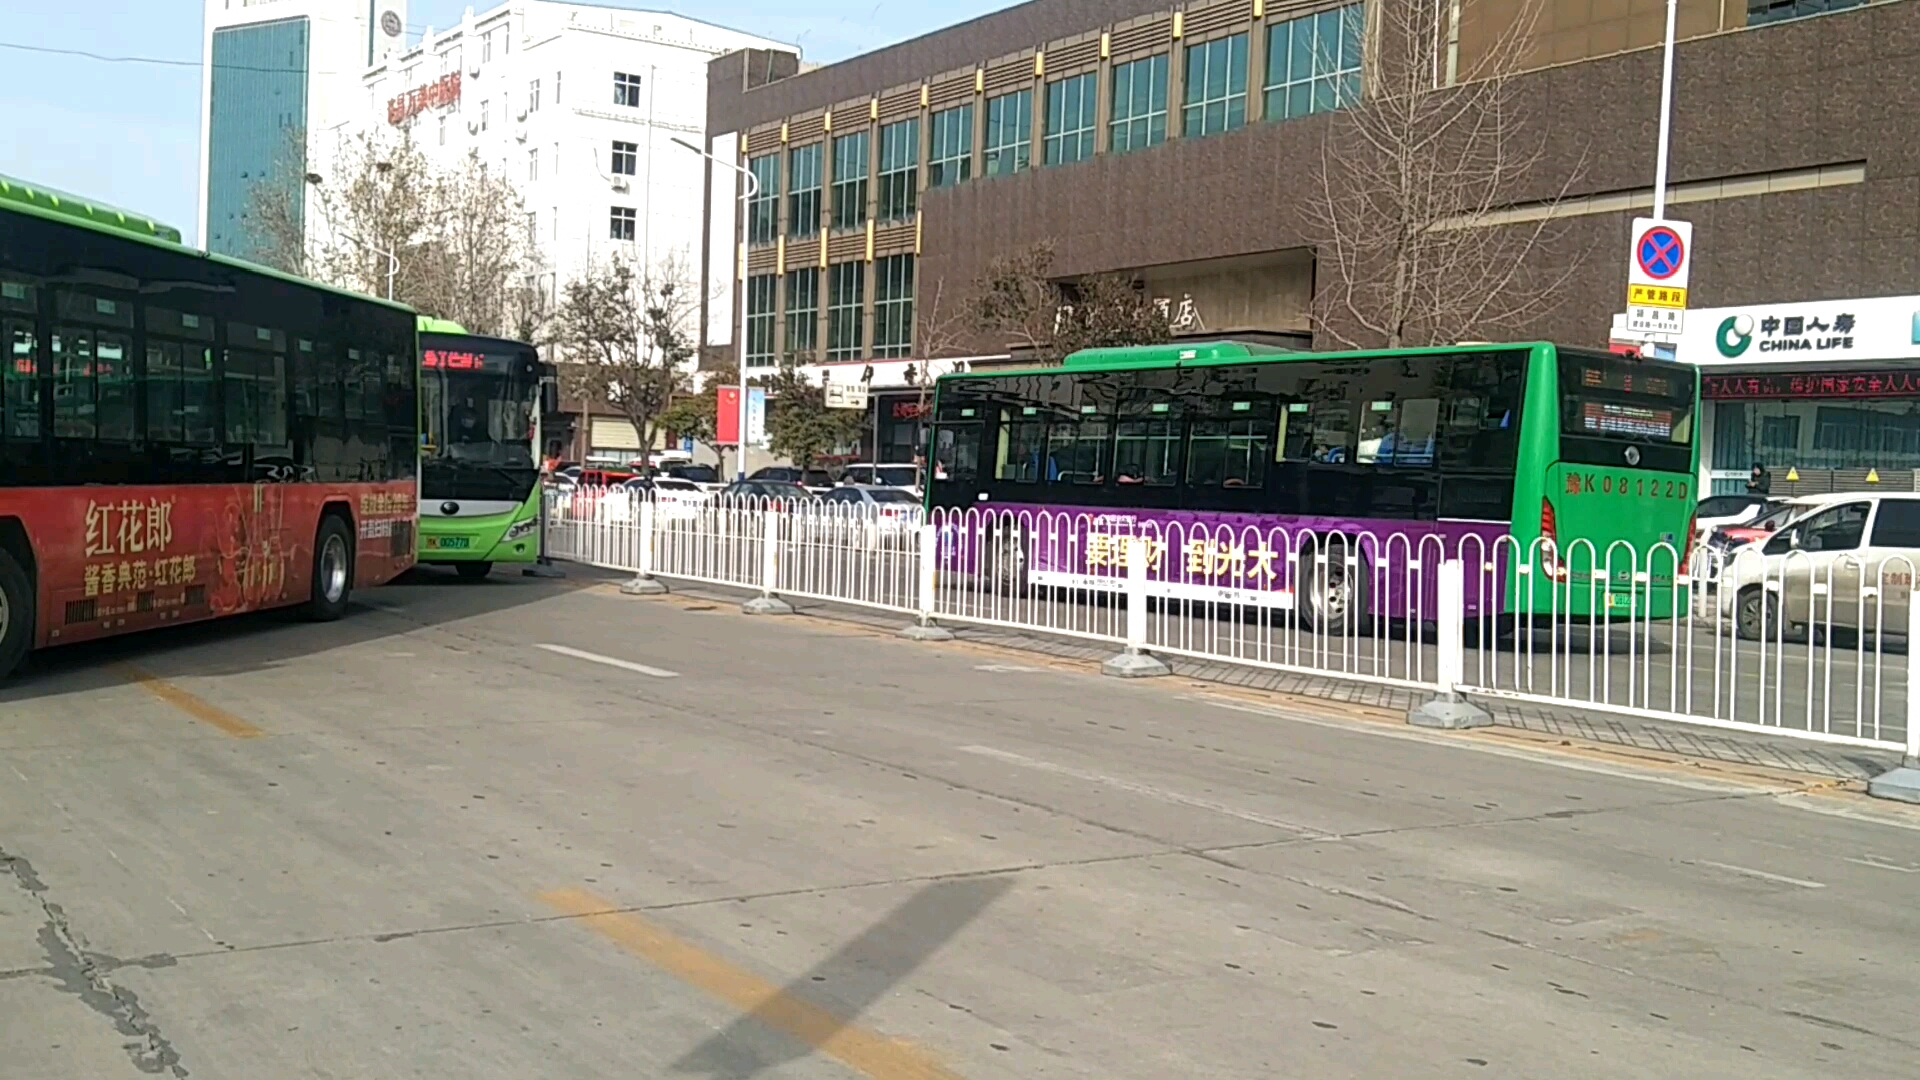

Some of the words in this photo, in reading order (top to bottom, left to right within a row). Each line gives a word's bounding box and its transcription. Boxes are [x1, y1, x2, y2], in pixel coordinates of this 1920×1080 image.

[1633, 287, 1681, 302] 严管路段
[1760, 313, 1856, 337] 中国人寿
[1759, 338, 1812, 352] CHINA
[1816, 336, 1854, 350] LIFE
[1565, 472, 1688, 500] 豫K08122D
[85, 497, 172, 558] 红花郎
